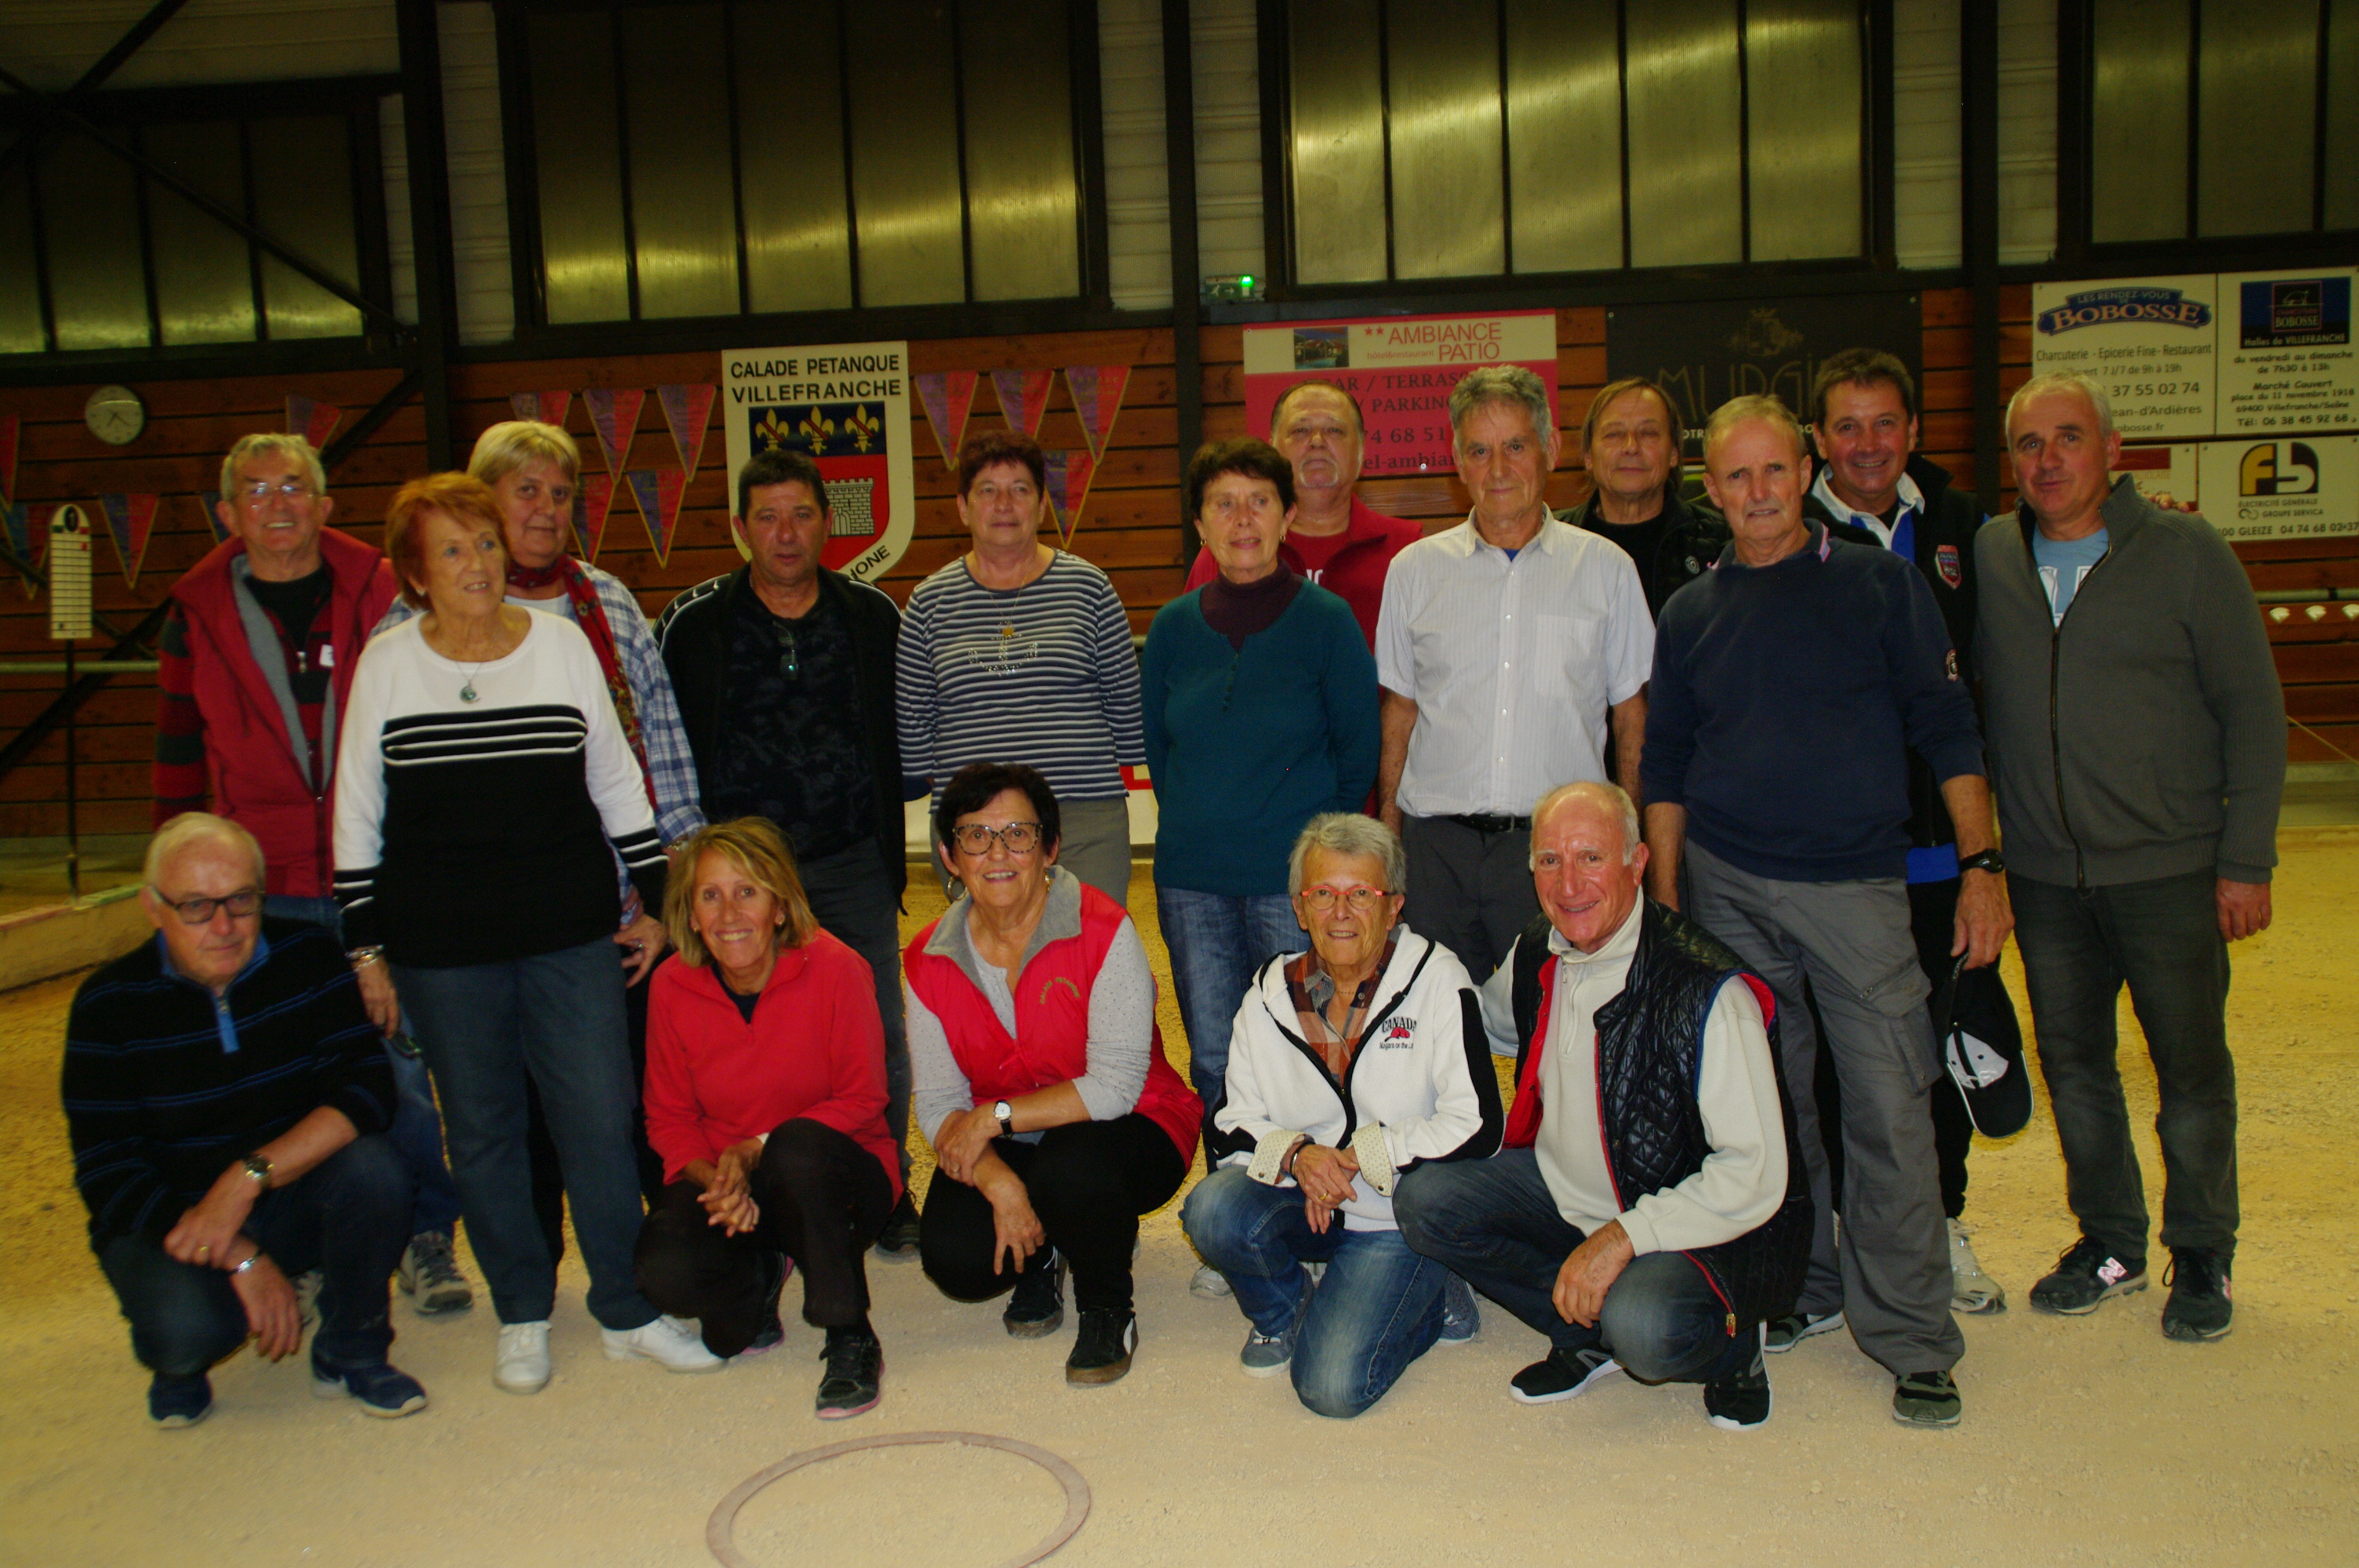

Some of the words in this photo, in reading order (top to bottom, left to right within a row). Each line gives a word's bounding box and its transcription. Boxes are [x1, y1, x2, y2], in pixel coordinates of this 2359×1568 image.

[2078, 295, 2095, 303] LES
[2098, 290, 2170, 300] RENDEZ-VOUS
[2052, 303, 2202, 331] BOBOSSE
[2275, 315, 2319, 328] BOBOSSE
[1388, 322, 1503, 345] AMBIANCE
[2245, 336, 2270, 347] Halles
[2273, 336, 2284, 345] de
[2285, 332, 2346, 345] VILLEFRANCHE
[1438, 342, 1500, 362] PATIO
[2036, 348, 2088, 361] Charcuterie
[2099, 347, 2135, 361] Epicerie
[2163, 344, 2212, 356] Restaurant
[2249, 353, 2291, 362] vendredi
[2310, 350, 2354, 360] dimanche
[730, 358, 798, 379] CALADE
[806, 354, 900, 375] PETANQUE
[2128, 365, 2140, 375] de
[2142, 364, 2154, 374] 9h
[2156, 364, 2162, 373] à
[2165, 363, 2183, 372] 19h
[2257, 365, 2270, 374] de
[2274, 363, 2299, 373] 7h30
[2302, 364, 2307, 372] à
[2312, 362, 2331, 372] 13h
[731, 379, 902, 403] VILLEFRANCHE
[2112, 385, 2130, 397] 37
[2135, 383, 2154, 396] 55
[2158, 383, 2177, 394] 02
[2182, 382, 2200, 394] 74
[2253, 380, 2290, 390] Marché
[2295, 379, 2333, 389] Couvert
[2231, 394, 2255, 403] place
[2111, 405, 2202, 417] ean-d'Ardières
[2236, 404, 2265, 413] 69400
[2267, 401, 2350, 412] Villefranche/Saône
[2237, 416, 2257, 426] Tél:
[2263, 416, 2277, 426] 06
[2281, 416, 2295, 425] 38
[2299, 415, 2313, 424] 45
[2317, 414, 2331, 423] 92
[2335, 413, 2349, 423] 68
[2117, 422, 2165, 432] obosse.fr
[1390, 428, 1416, 443] 68
[1424, 426, 1445, 441] 51
[2262, 510, 2292, 518] GROUPE
[2293, 508, 2324, 517] SERVICA
[2239, 526, 2274, 536] GLEIZE
[2281, 525, 2294, 534] 04
[2298, 524, 2309, 533] 74
[2314, 523, 2327, 532] 68
